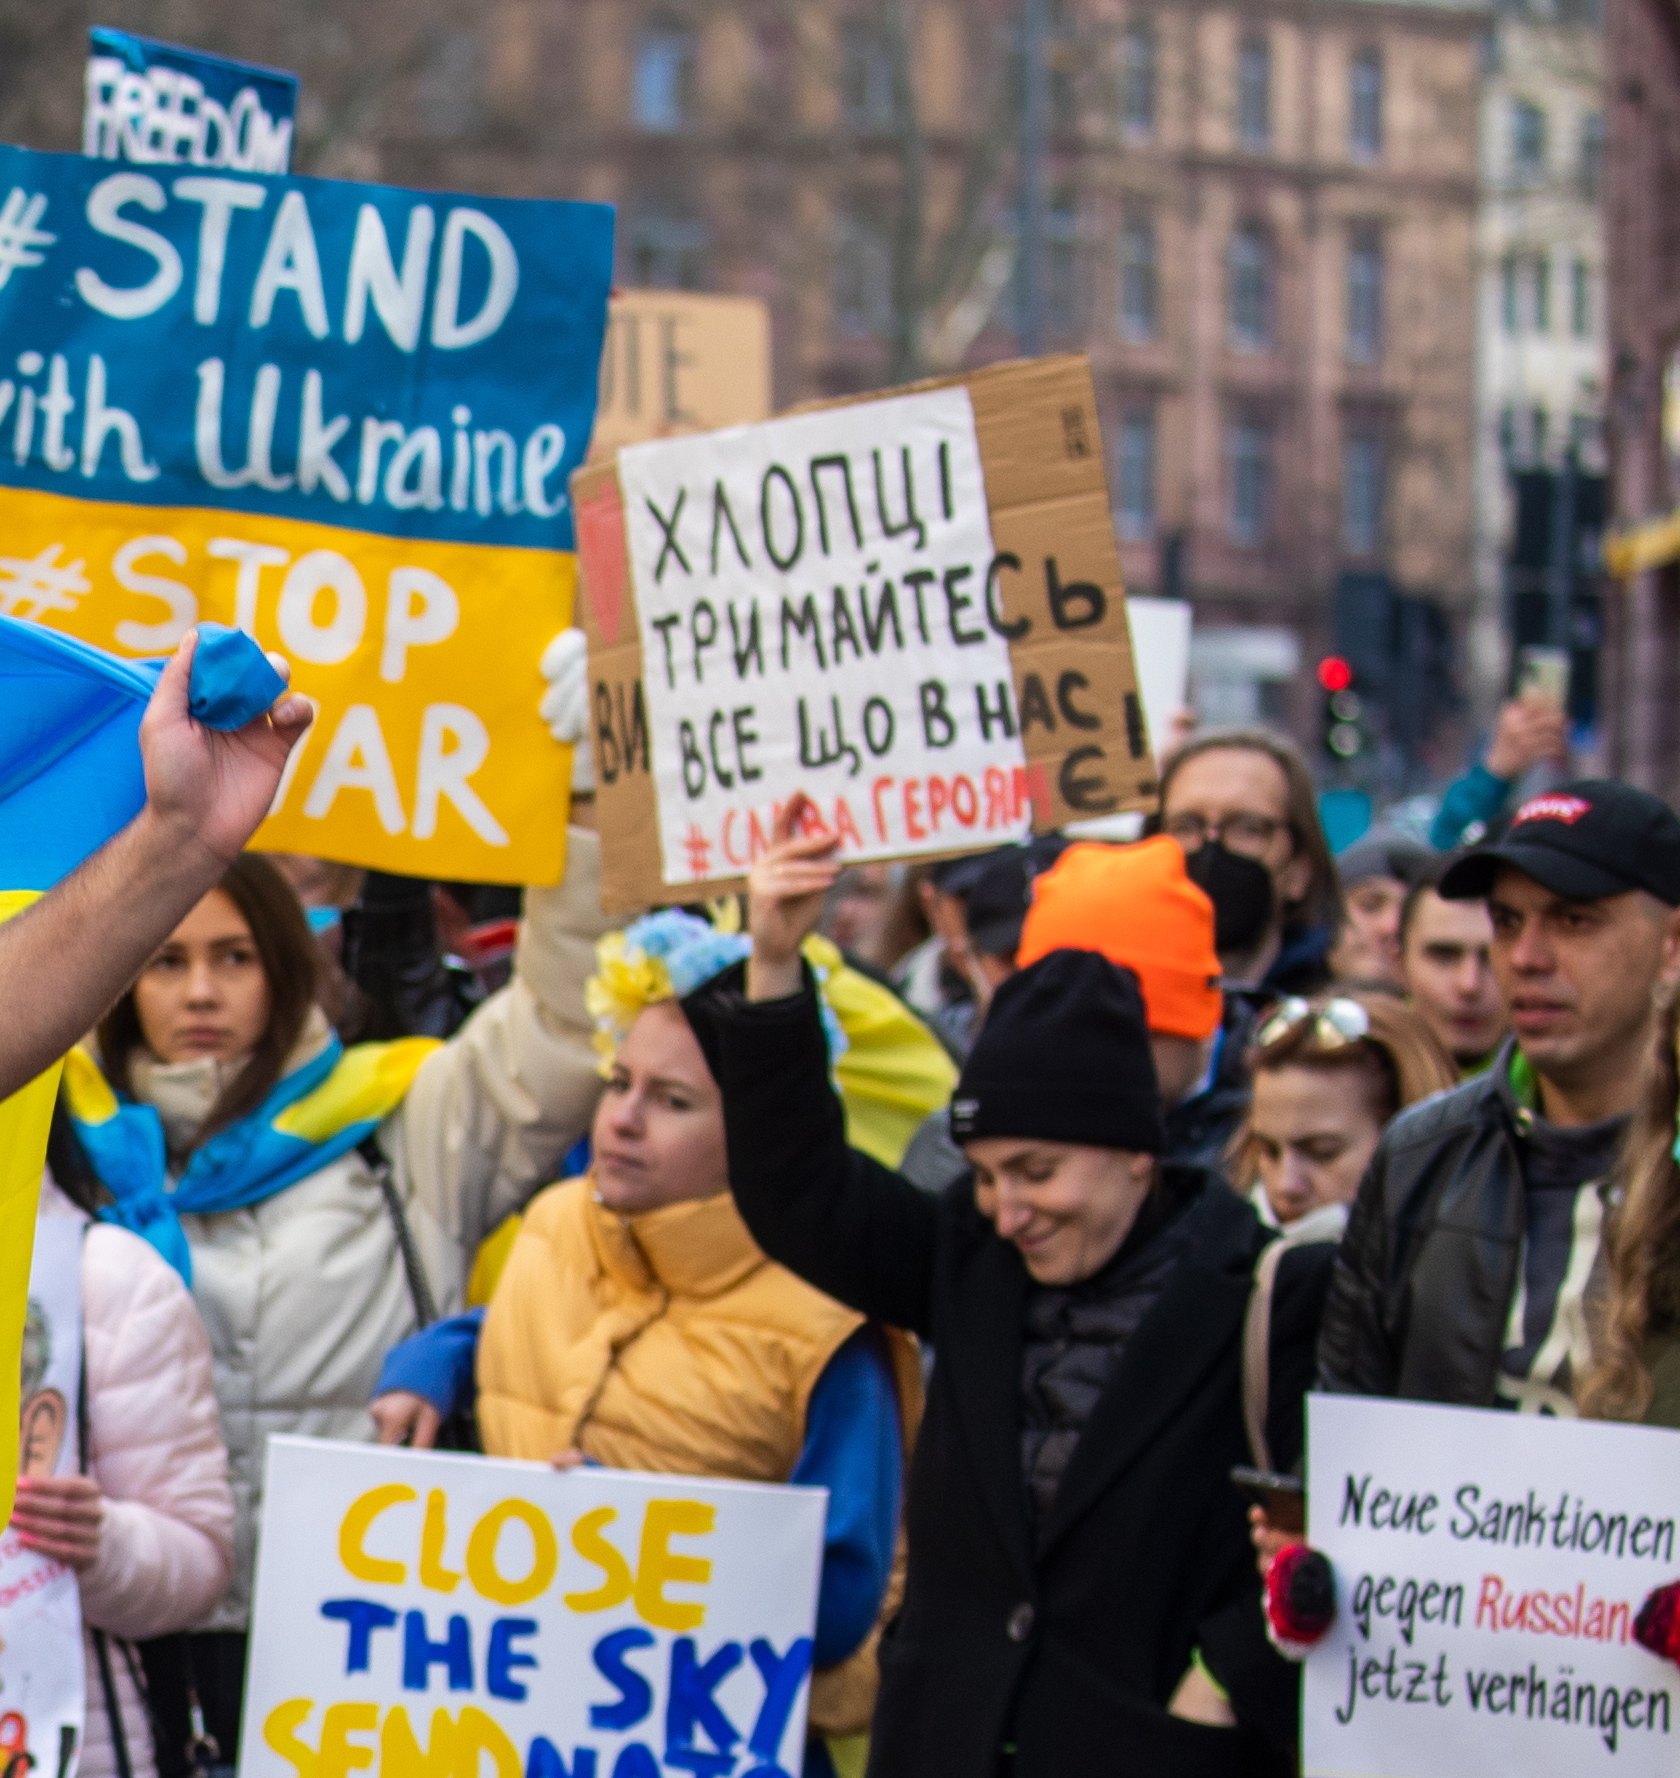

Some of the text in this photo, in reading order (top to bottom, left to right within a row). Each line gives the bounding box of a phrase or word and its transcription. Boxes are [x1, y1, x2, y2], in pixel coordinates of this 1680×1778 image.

[84, 55, 293, 178] FREEDOM
[193, 355, 568, 518] Ukraine
[646, 441, 955, 585] ХЛОПЦІ
[652, 552, 1108, 690] ТРИМАЙТЕСЬ
[269, 700, 511, 847] AR
[679, 705, 762, 800] ВСЕ
[921, 679, 958, 749] В
[871, 762, 1052, 844] ГЕРОЯМ
[339, 1483, 716, 1632] CLOSE
[1339, 1471, 1675, 1564] Neue Sanktionen
[1353, 1572, 1636, 1647] gegen Russlan
[321, 1599, 815, 1763] THE SKY
[1335, 1645, 1671, 1754] jetzt verhängen
